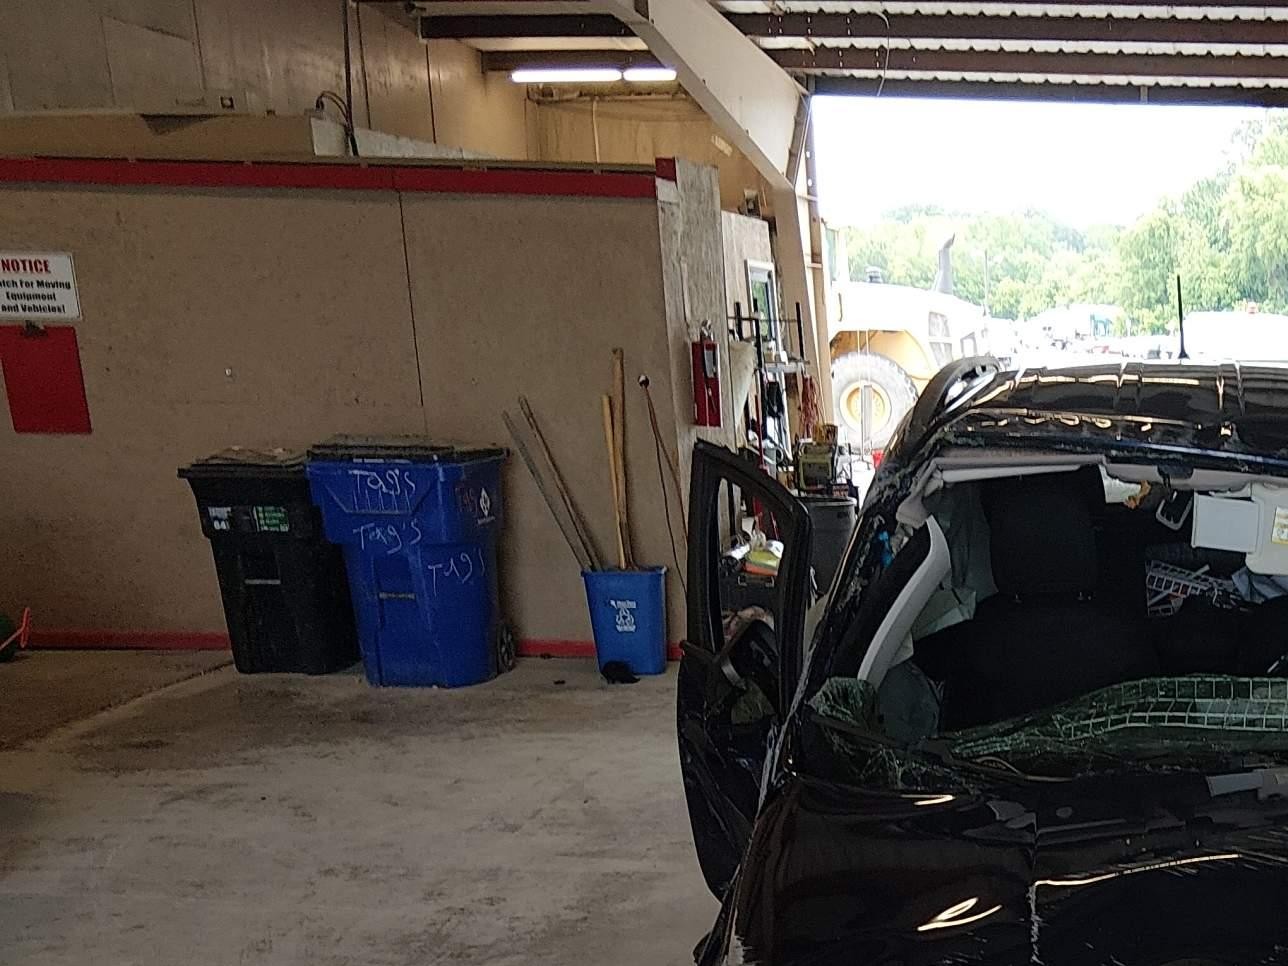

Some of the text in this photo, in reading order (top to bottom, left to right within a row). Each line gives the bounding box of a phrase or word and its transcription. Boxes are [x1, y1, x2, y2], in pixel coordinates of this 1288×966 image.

[1, 258, 51, 273] NOTICE
[37, 280, 71, 290] Moving
[6, 291, 57, 301] Equipment
[21, 304, 66, 314] Vehicles!
